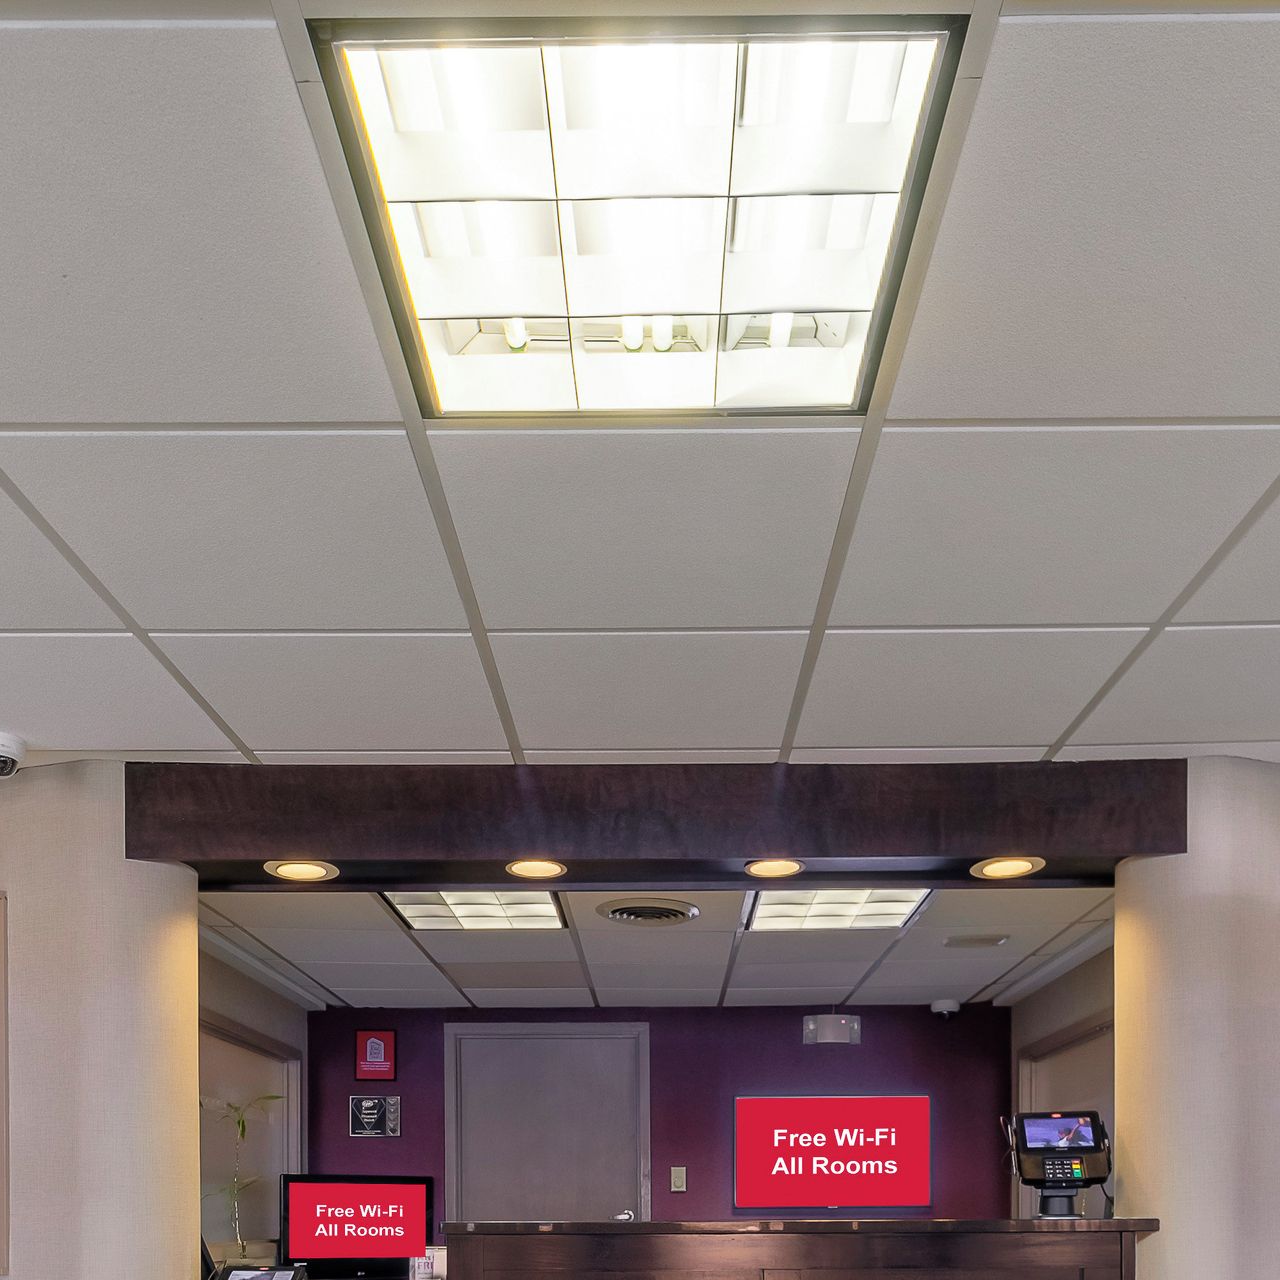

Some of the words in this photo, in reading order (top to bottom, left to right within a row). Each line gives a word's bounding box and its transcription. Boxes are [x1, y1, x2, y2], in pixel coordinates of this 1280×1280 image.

[773, 1129, 826, 1147] Free
[834, 1128, 896, 1147] Wi-Fi
[771, 1157, 803, 1175] All
[812, 1156, 898, 1174] Rooms
[316, 1204, 355, 1218] Free
[360, 1205, 404, 1218] Wi-Fi
[315, 1224, 338, 1236] All
[344, 1224, 405, 1236] Rooms
